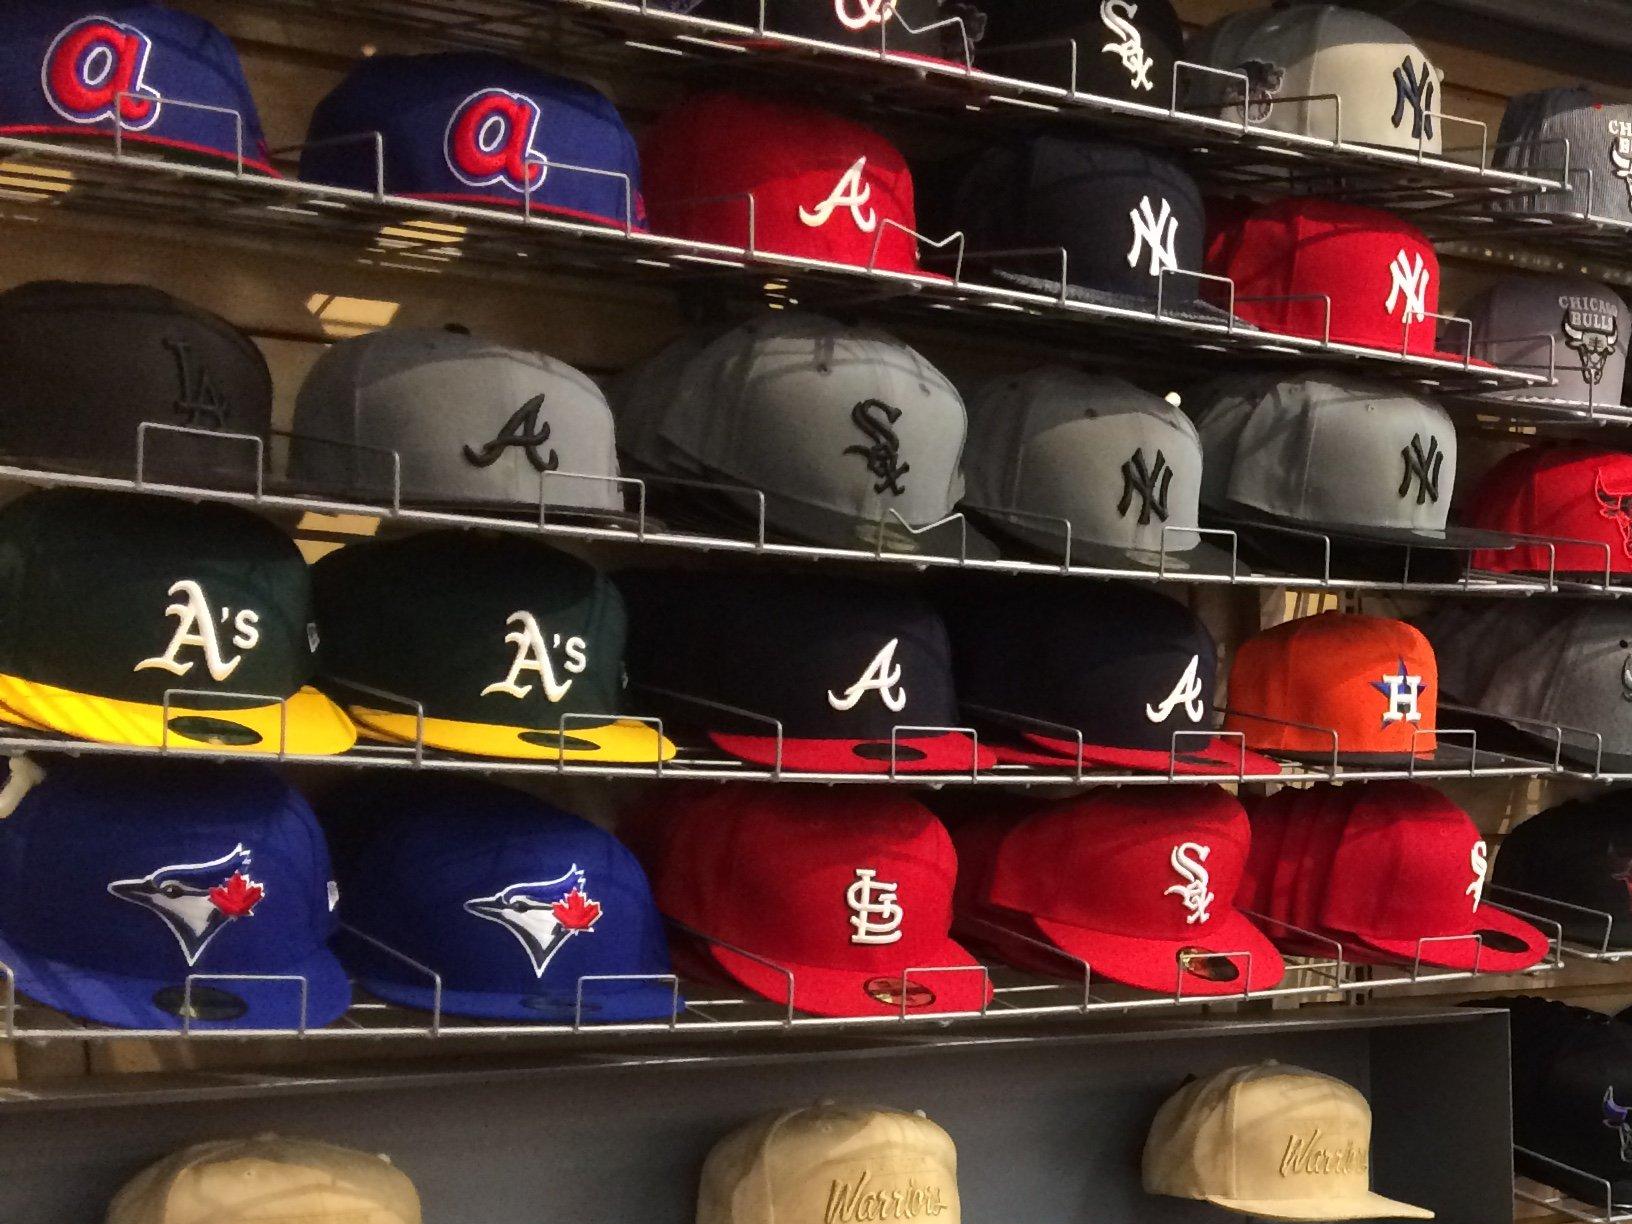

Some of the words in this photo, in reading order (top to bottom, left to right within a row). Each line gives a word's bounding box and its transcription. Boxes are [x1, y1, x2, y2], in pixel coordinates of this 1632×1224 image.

[1391, 54, 1434, 140] NY
[799, 156, 876, 232] A
[1127, 196, 1179, 276] NY
[1386, 249, 1430, 324] NY
[463, 394, 558, 472] A
[1400, 433, 1444, 504] NY
[1118, 447, 1173, 524] NY
[134, 579, 260, 682] A's
[480, 610, 587, 702] A's
[827, 638, 906, 711] A
[1146, 655, 1204, 723] A
